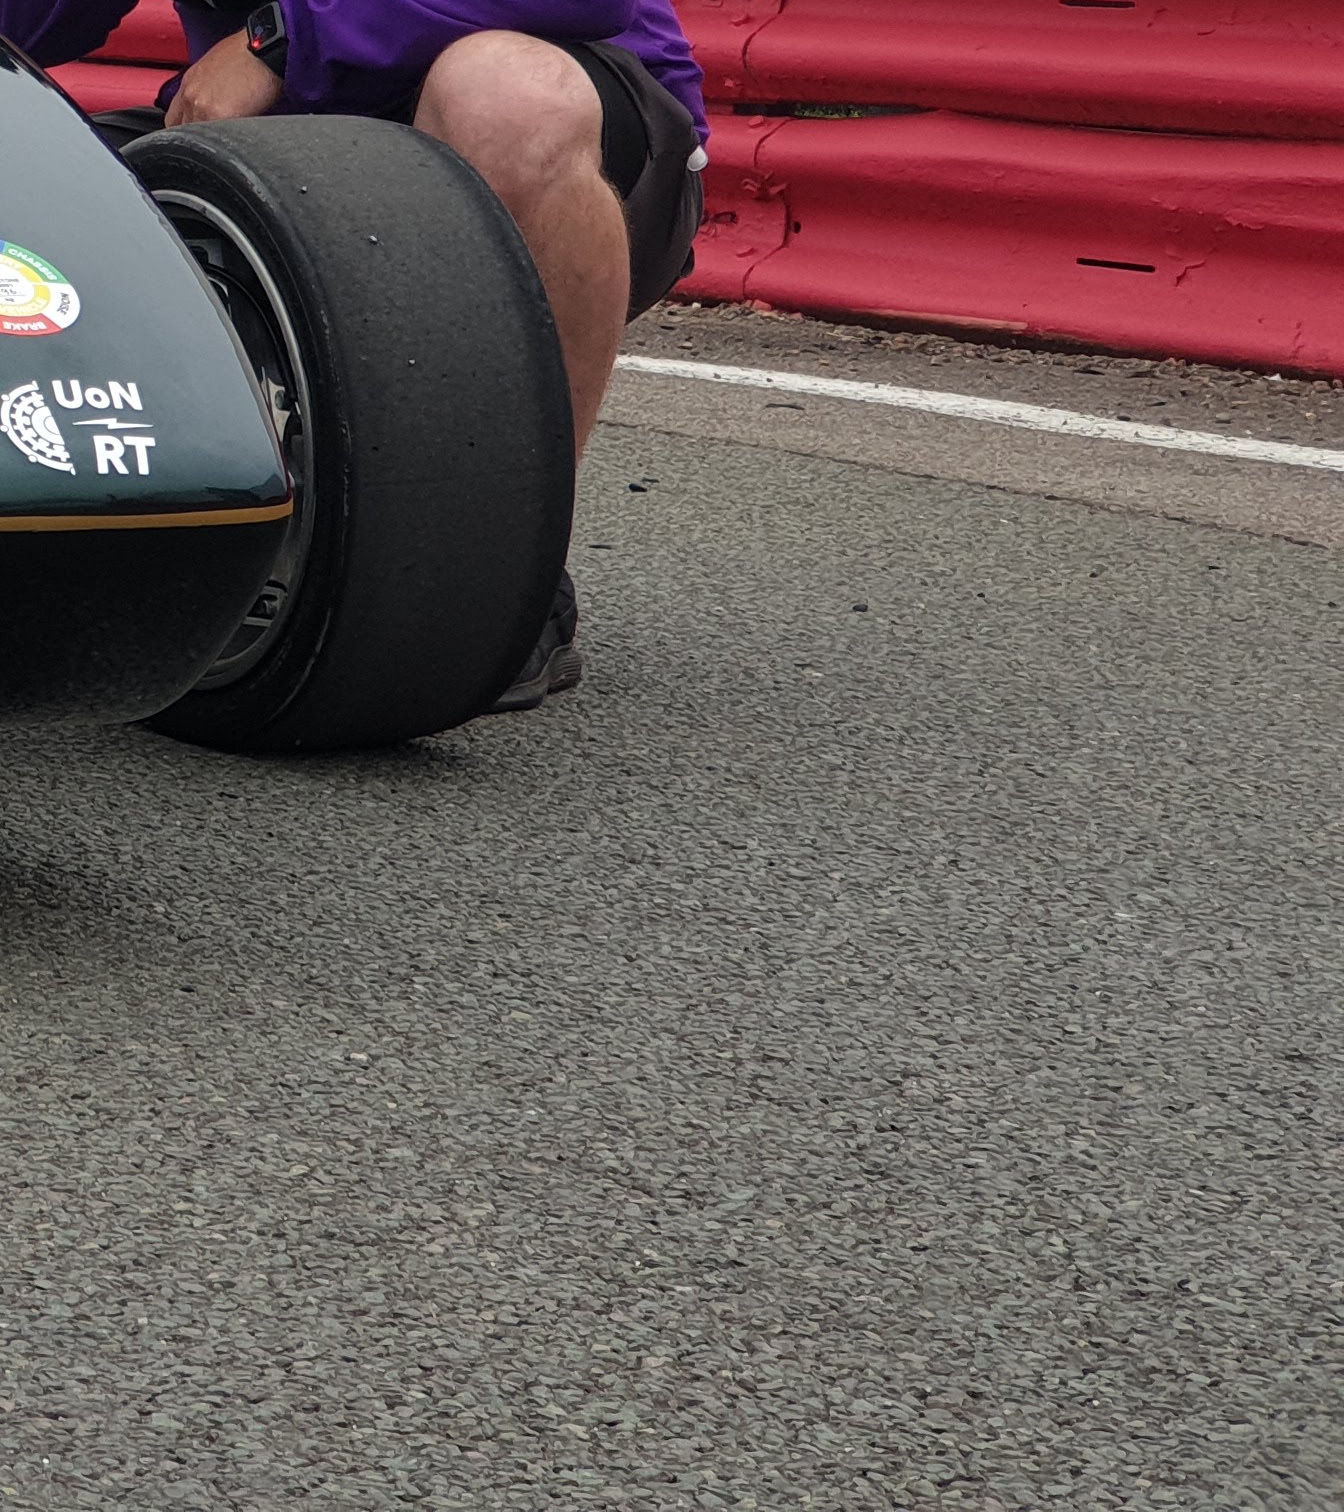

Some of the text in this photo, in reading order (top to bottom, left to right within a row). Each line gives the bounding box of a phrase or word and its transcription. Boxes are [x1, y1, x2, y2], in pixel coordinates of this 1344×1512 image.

[7, 248, 57, 281] CHASSIS
[3, 321, 48, 331] BRAKE
[52, 379, 143, 410] UoN
[93, 435, 156, 476] RT
